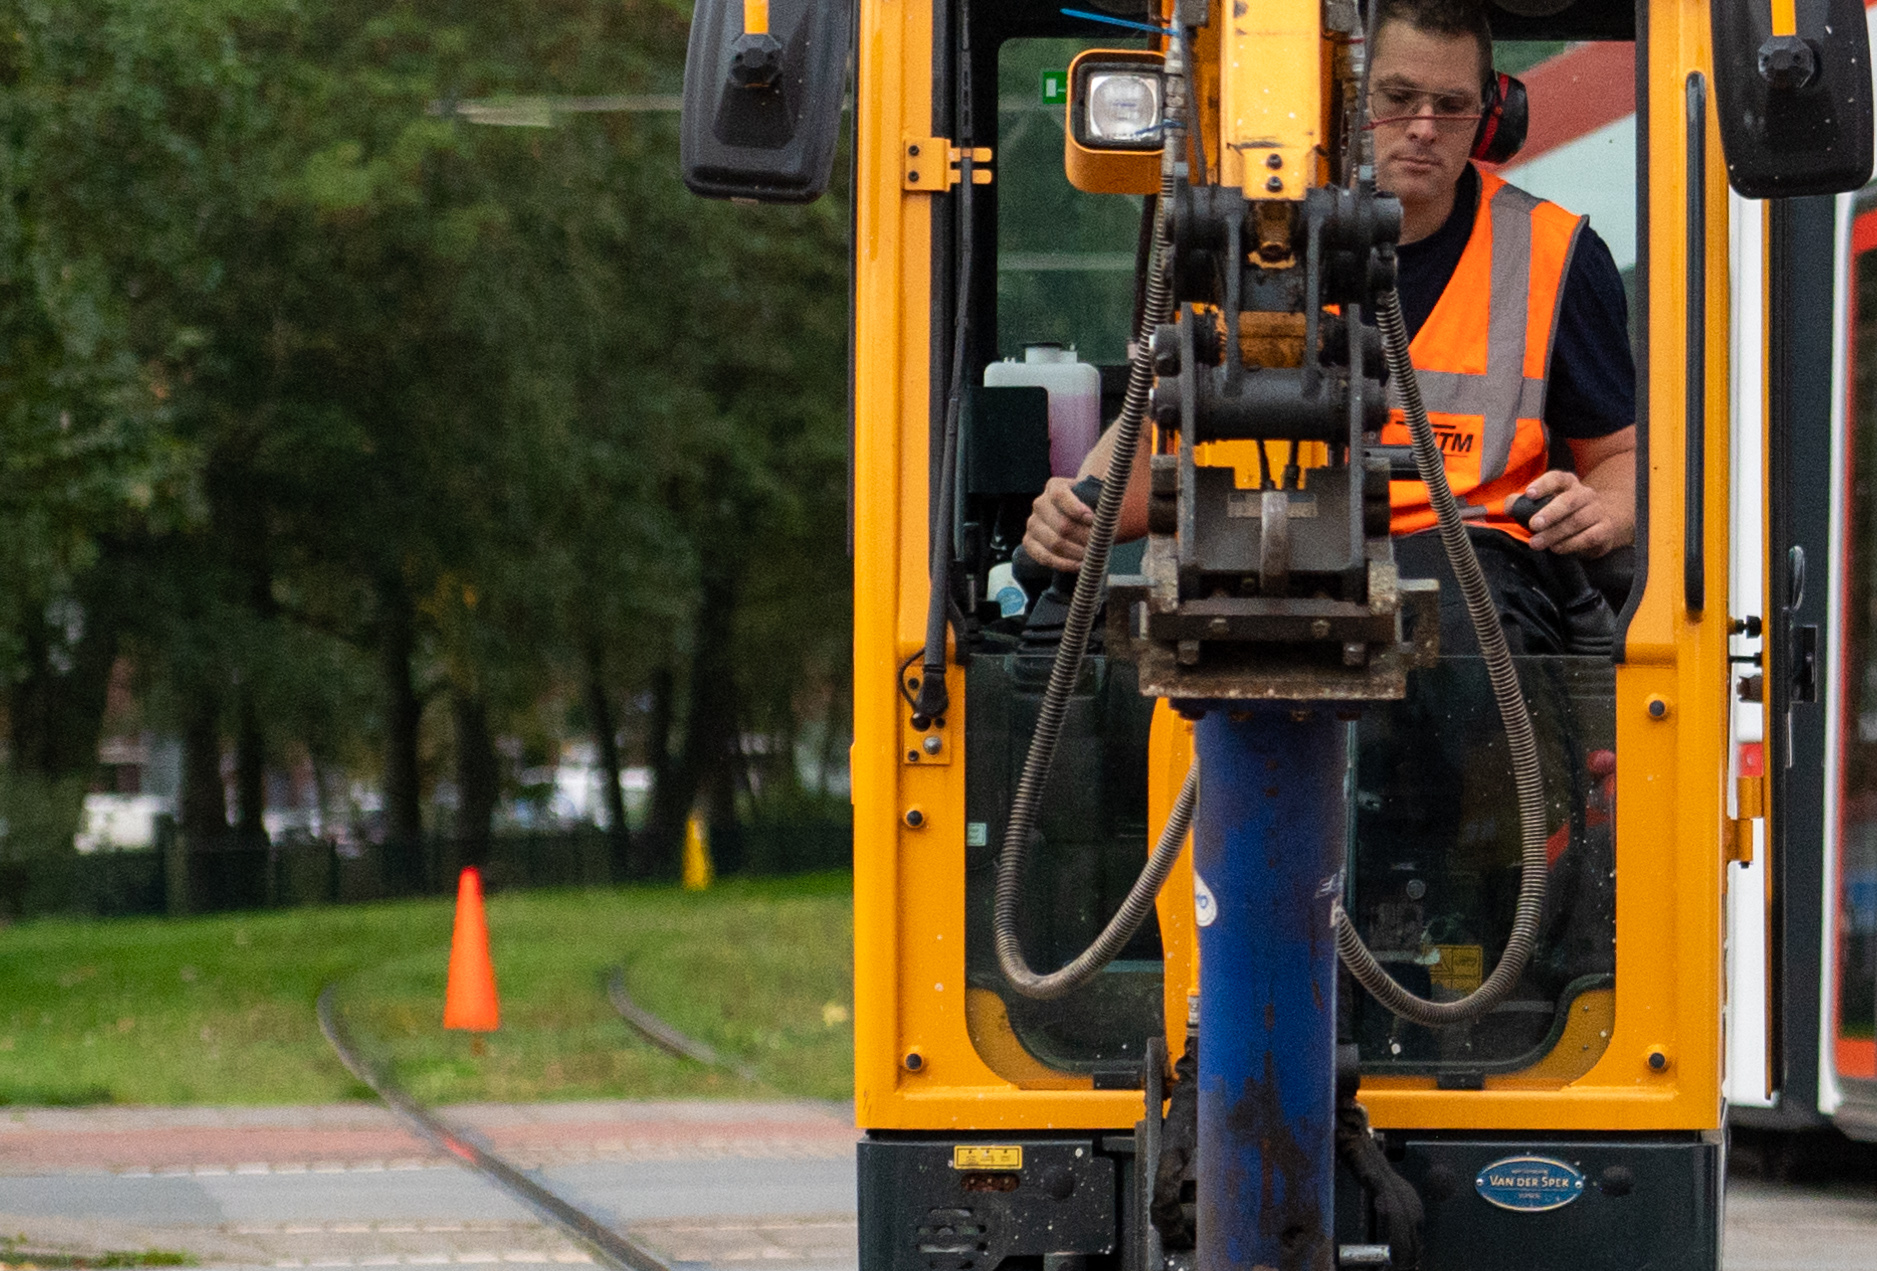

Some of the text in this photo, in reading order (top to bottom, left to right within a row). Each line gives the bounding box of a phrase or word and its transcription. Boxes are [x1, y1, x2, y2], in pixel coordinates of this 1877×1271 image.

[1490, 1175, 1570, 1187] VAN DER SPEK
